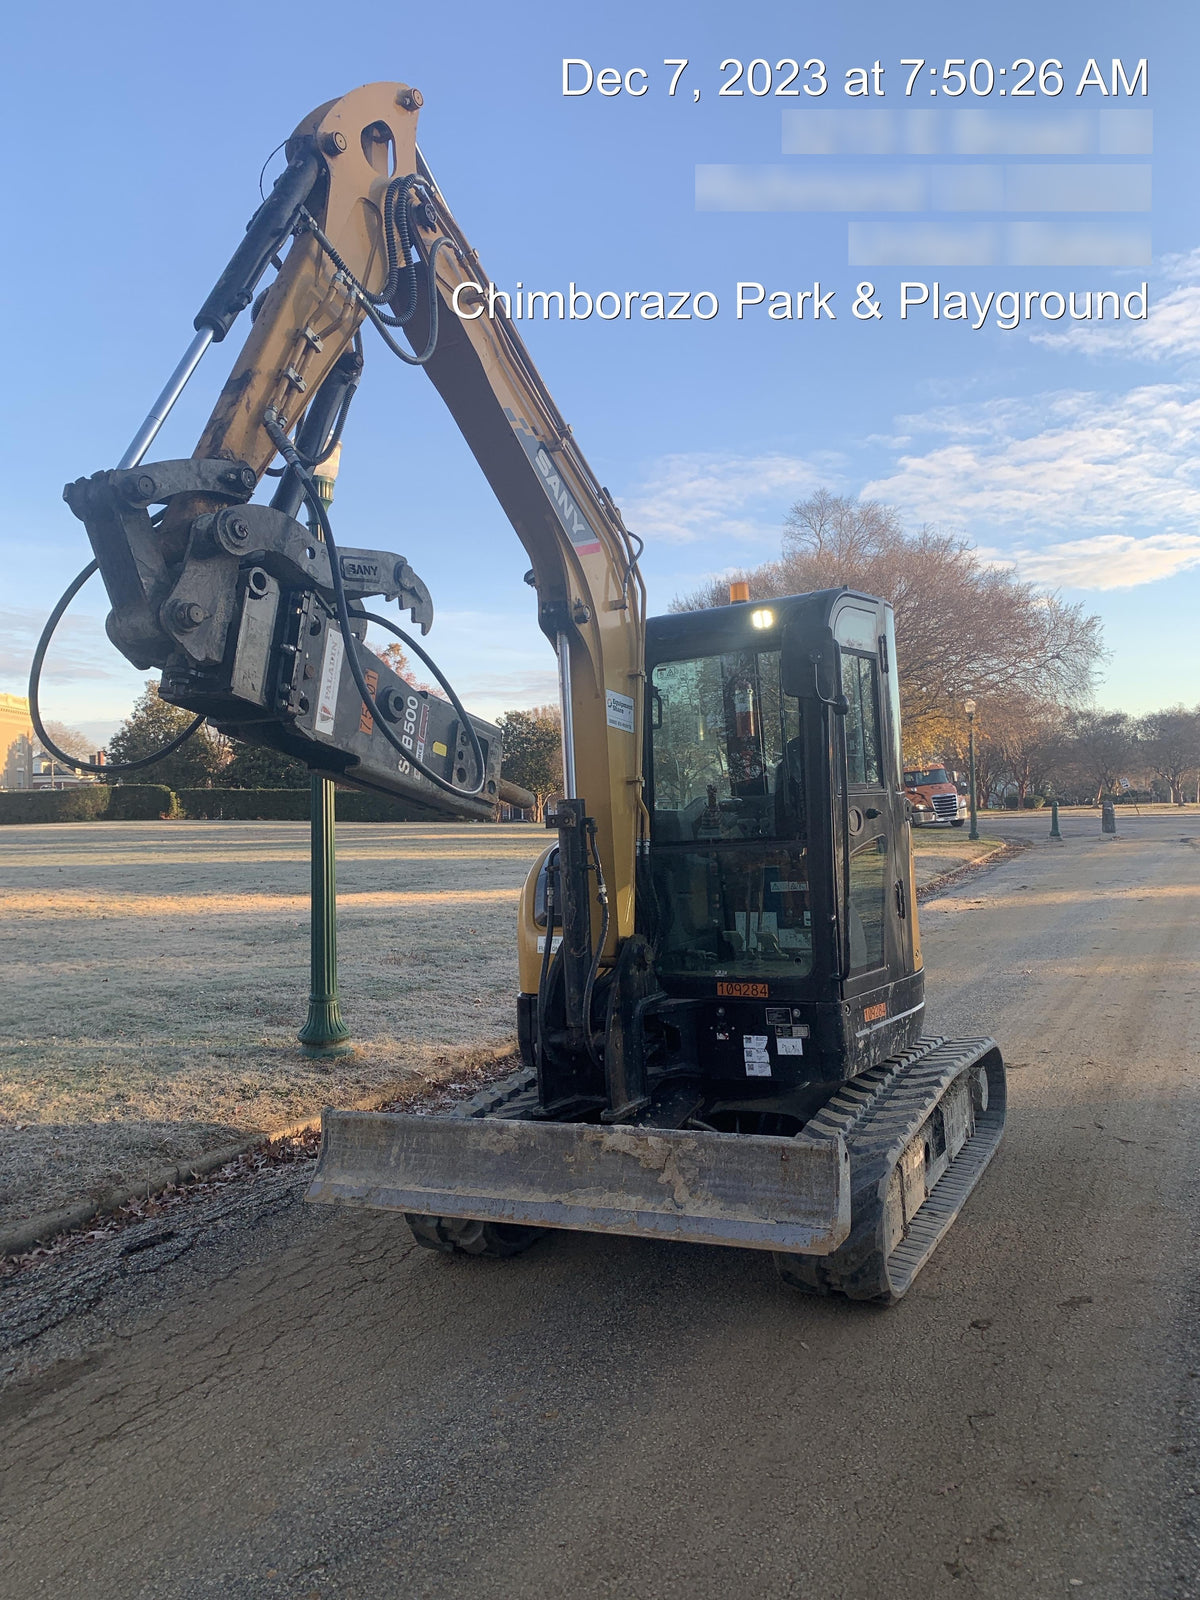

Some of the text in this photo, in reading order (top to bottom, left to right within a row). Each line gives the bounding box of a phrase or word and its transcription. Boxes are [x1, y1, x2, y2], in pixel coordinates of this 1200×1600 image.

[535, 449, 585, 533] SANY
[348, 563, 378, 576] SANY
[324, 641, 338, 700] PALADIN
[398, 695, 418, 775] SB500
[719, 984, 768, 996] 109284
